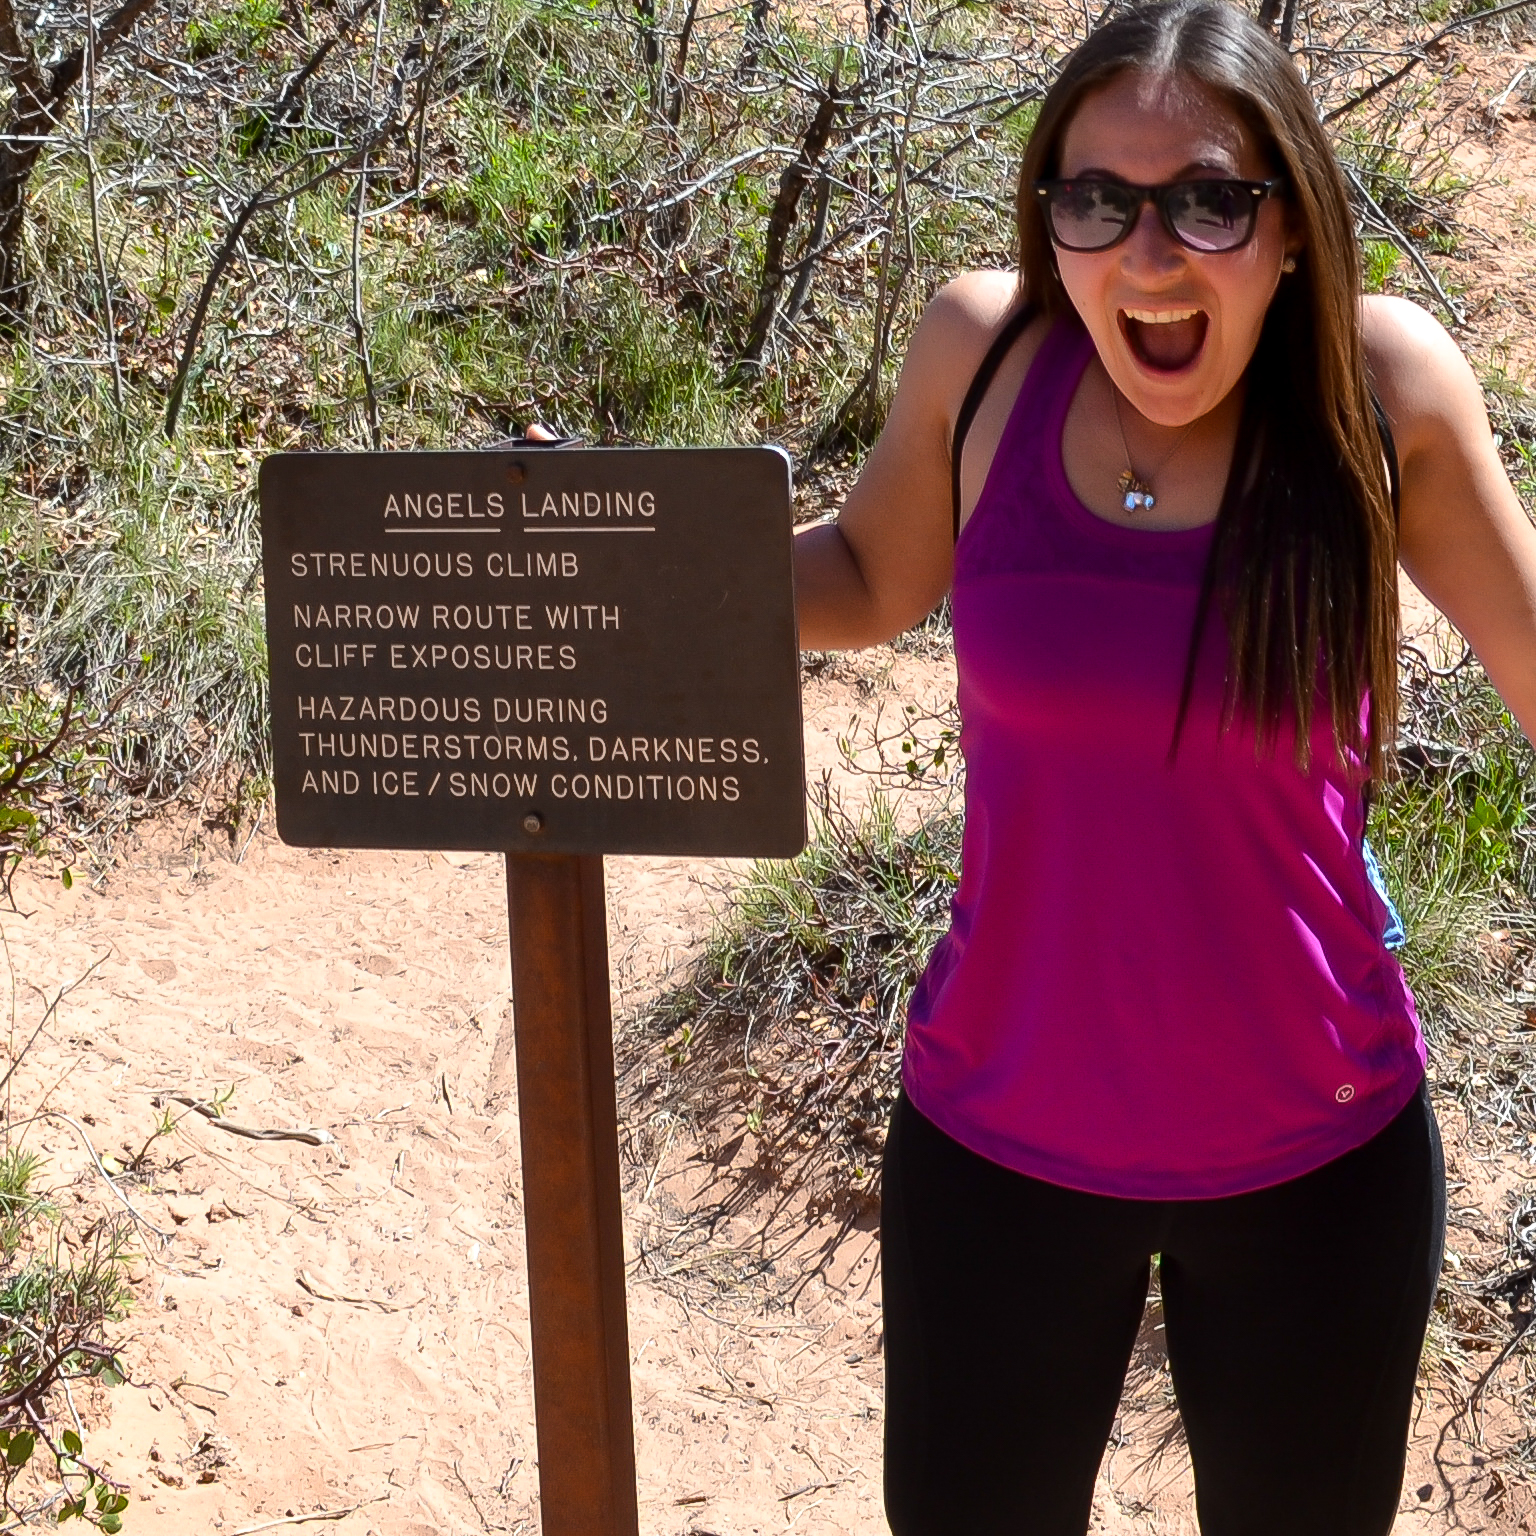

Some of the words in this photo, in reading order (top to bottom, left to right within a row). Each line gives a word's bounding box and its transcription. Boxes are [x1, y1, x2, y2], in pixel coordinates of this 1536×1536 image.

[384, 492, 505, 519] ANGELS
[521, 491, 656, 518] LANDING
[291, 552, 473, 578] STRENUOUS
[487, 552, 579, 577] CLIMB
[294, 604, 420, 630] NARROW
[432, 604, 533, 630] ROUTE
[544, 604, 620, 631] WITH
[295, 643, 377, 668] CLIFF
[390, 644, 577, 670] EXPOSURES
[298, 695, 481, 723] HAZARDOUS
[493, 697, 607, 724] DURING
[589, 736, 769, 765] DARKNESS,
[301, 769, 360, 795] AND
[551, 773, 740, 802] CONDITIONS
